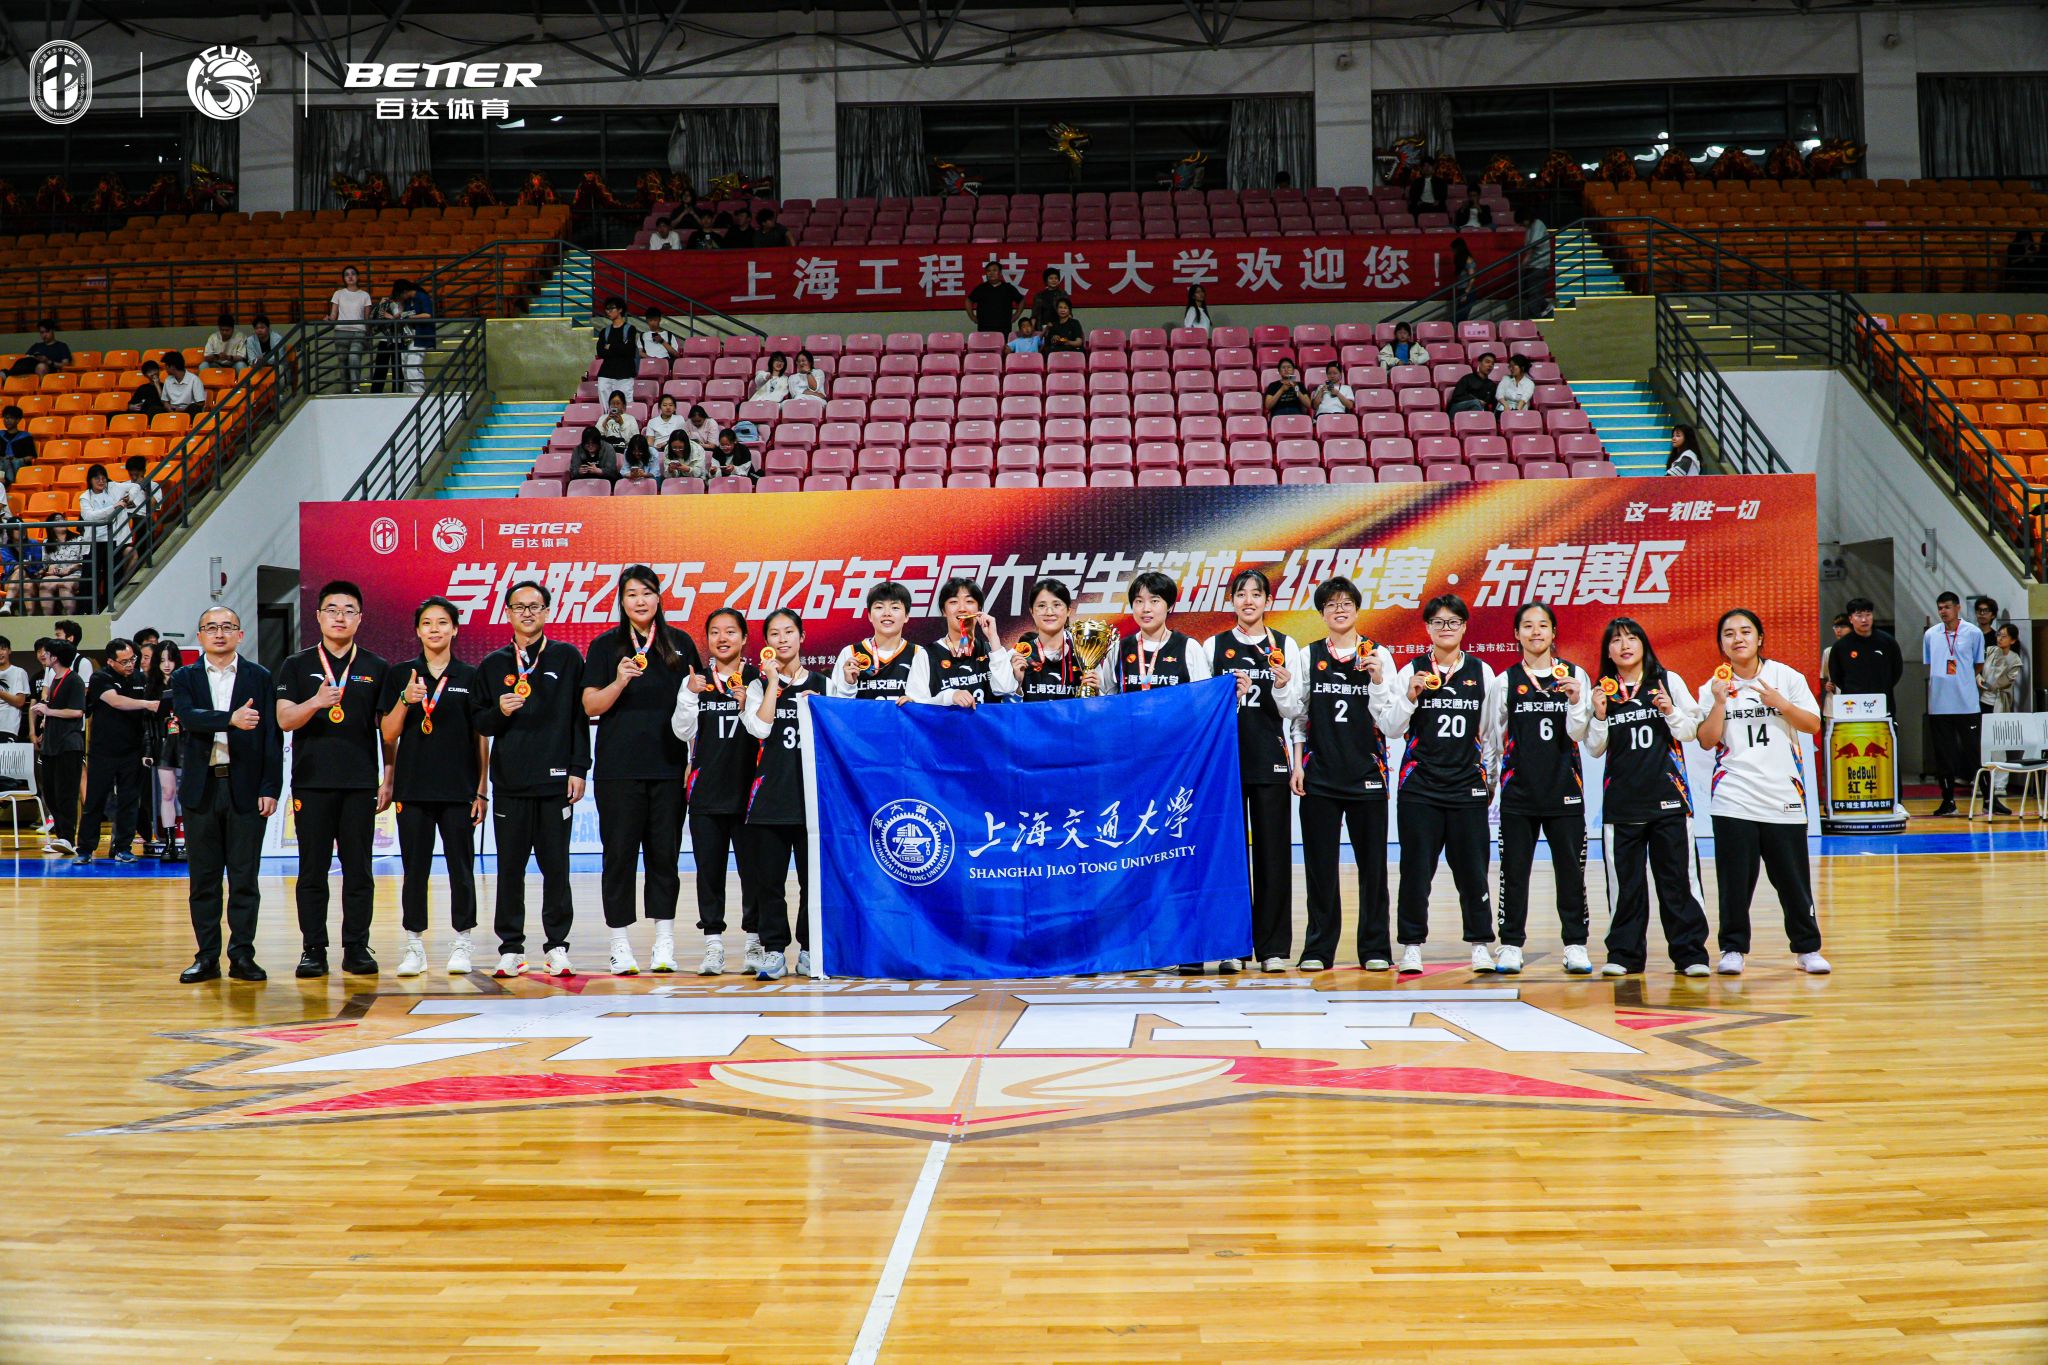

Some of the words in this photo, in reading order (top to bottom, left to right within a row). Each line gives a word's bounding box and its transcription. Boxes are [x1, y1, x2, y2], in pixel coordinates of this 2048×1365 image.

[1624, 500, 1761, 522] 这一刻胜一切
[499, 522, 583, 535] BETTER
[511, 538, 569, 548] 百达体育
[1334, 700, 1348, 722] 2
[718, 716, 739, 738] 17
[1437, 714, 1466, 738] 20
[1539, 718, 1553, 741] 6
[1747, 724, 1769, 747] 14
[1631, 725, 1654, 750] 10
[1848, 780, 1877, 794] 红牛
[969, 866, 1042, 879] SHANGHAI
[1046, 864, 1076, 879] JIAO
[1078, 861, 1117, 874] TONG
[1120, 845, 1197, 869] UNIVERSITY
[648, 983, 970, 995] CUBAL
